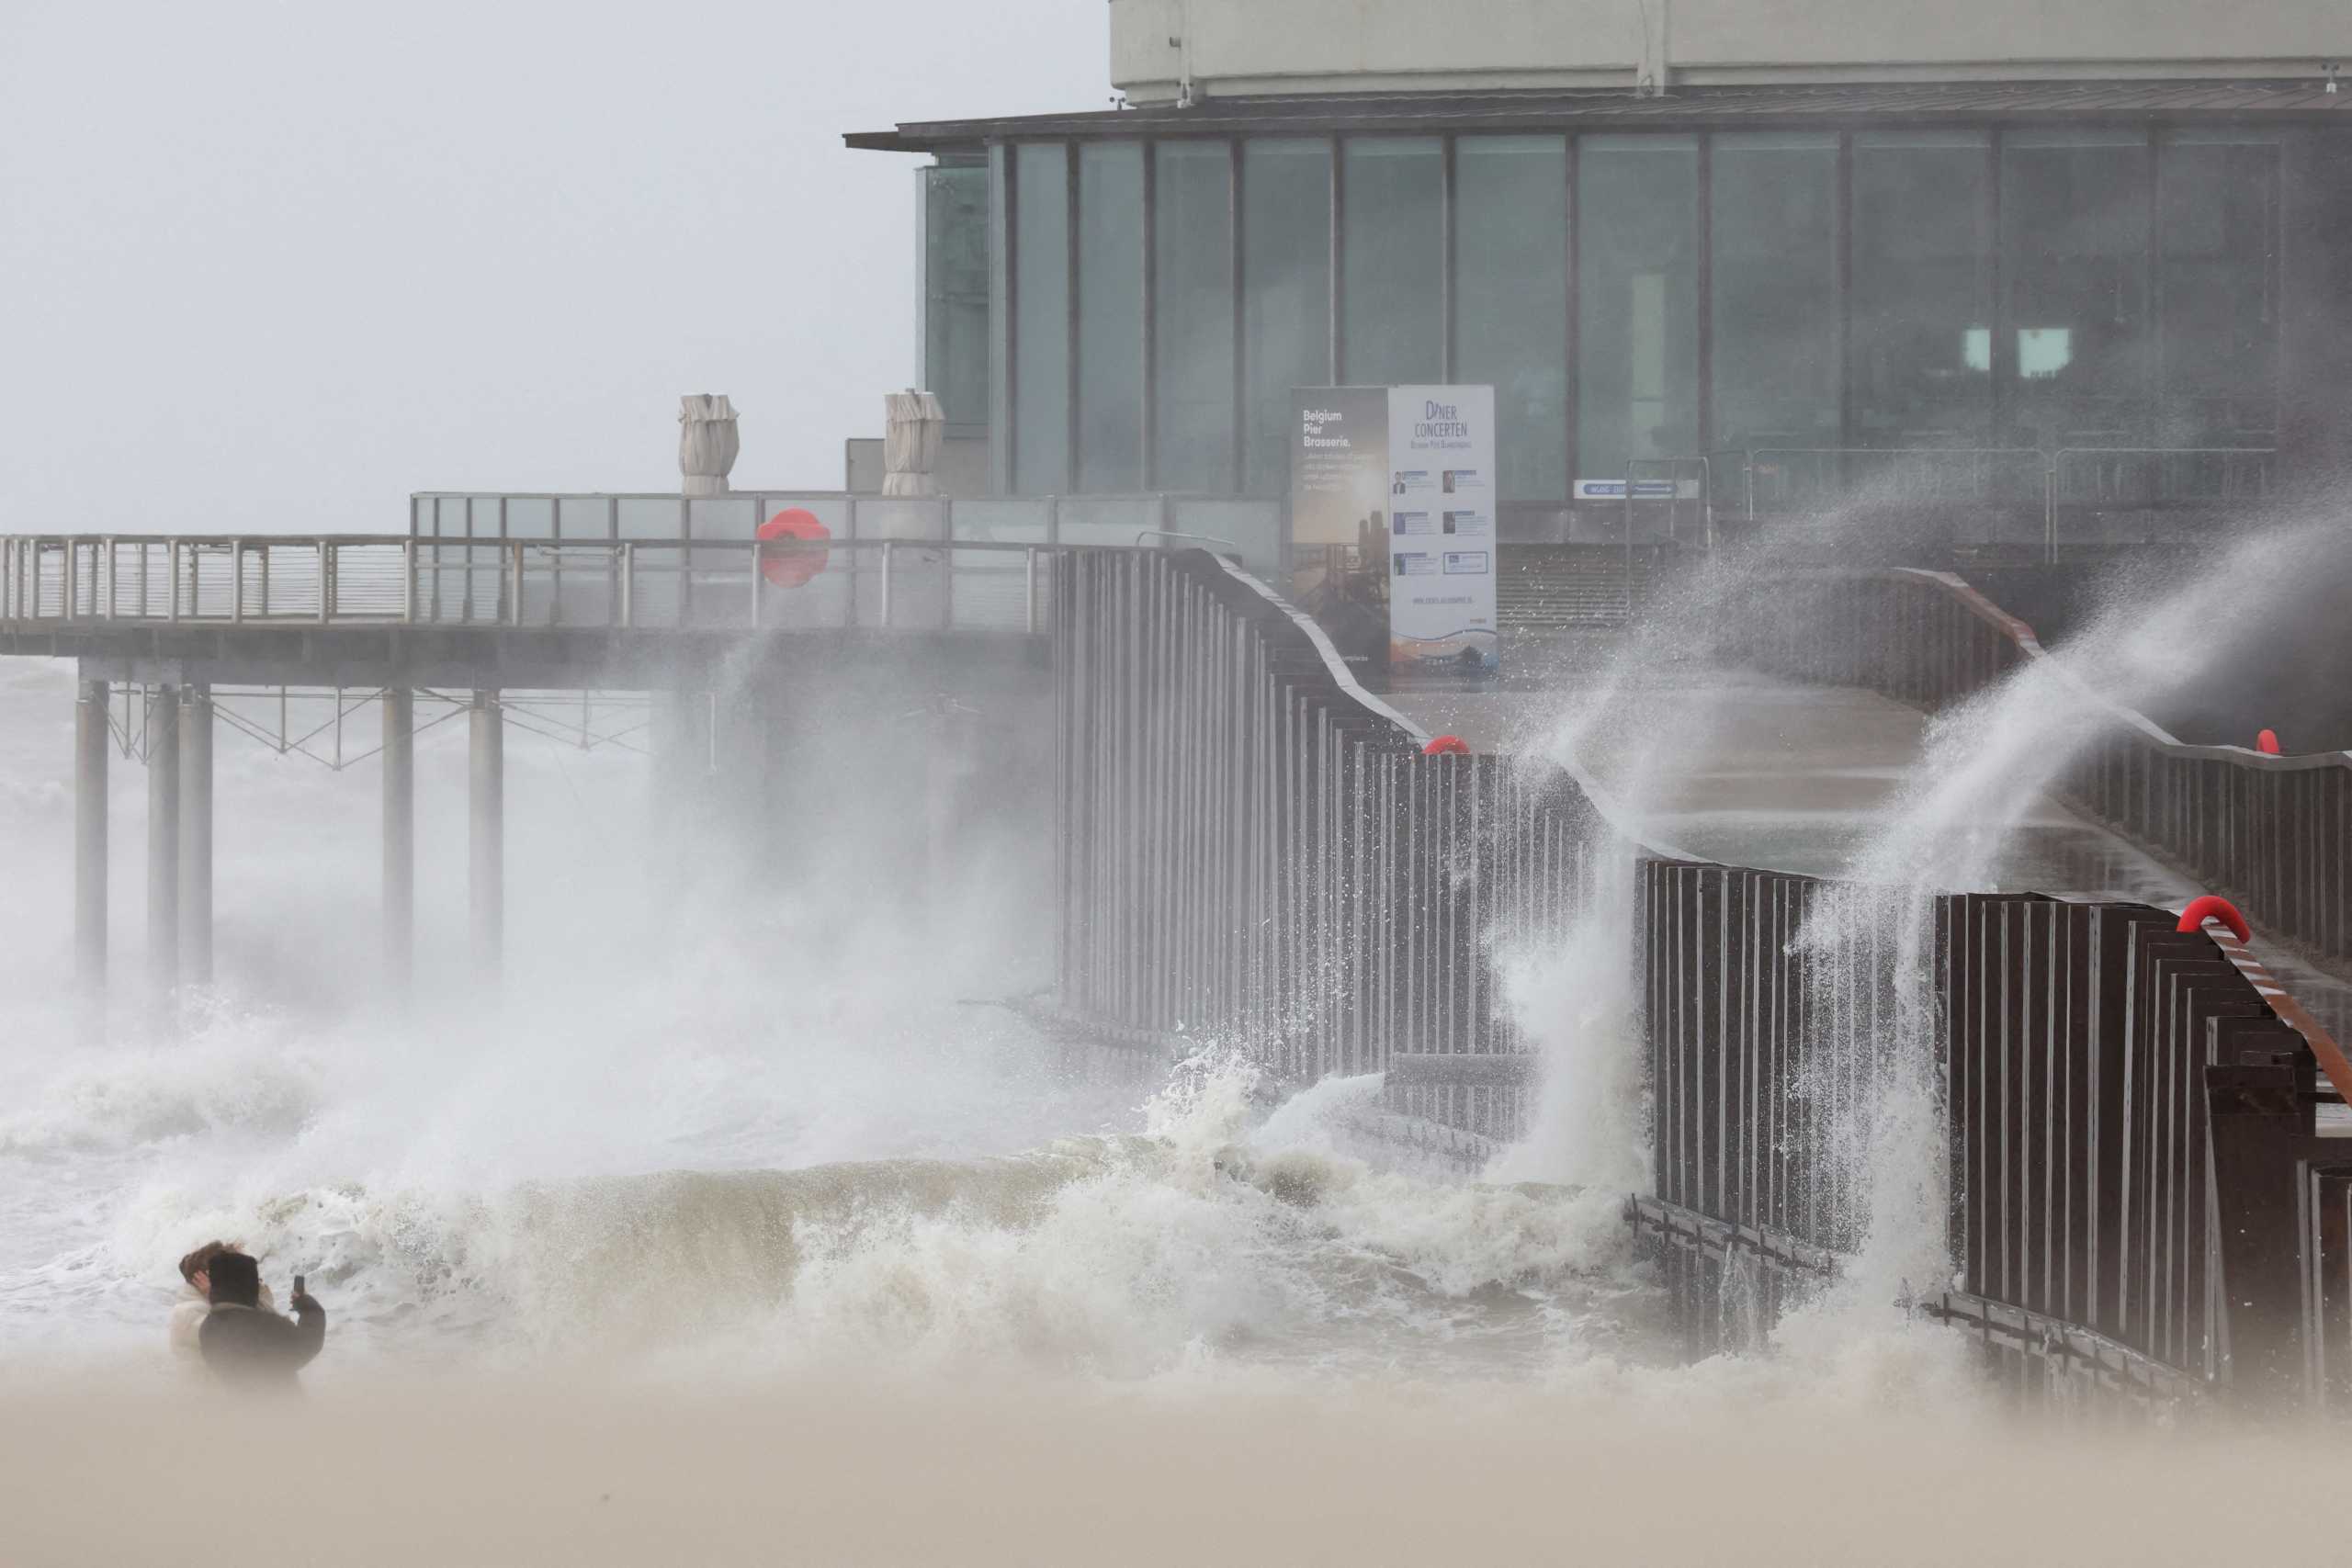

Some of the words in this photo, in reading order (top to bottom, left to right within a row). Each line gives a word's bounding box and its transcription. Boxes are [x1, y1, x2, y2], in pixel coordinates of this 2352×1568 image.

[1304, 410, 1341, 423] Belgium
[1304, 423, 1322, 434] Pier
[1415, 422, 1467, 437] CONCERTEN
[1304, 436, 1351, 447] Brasserie.
